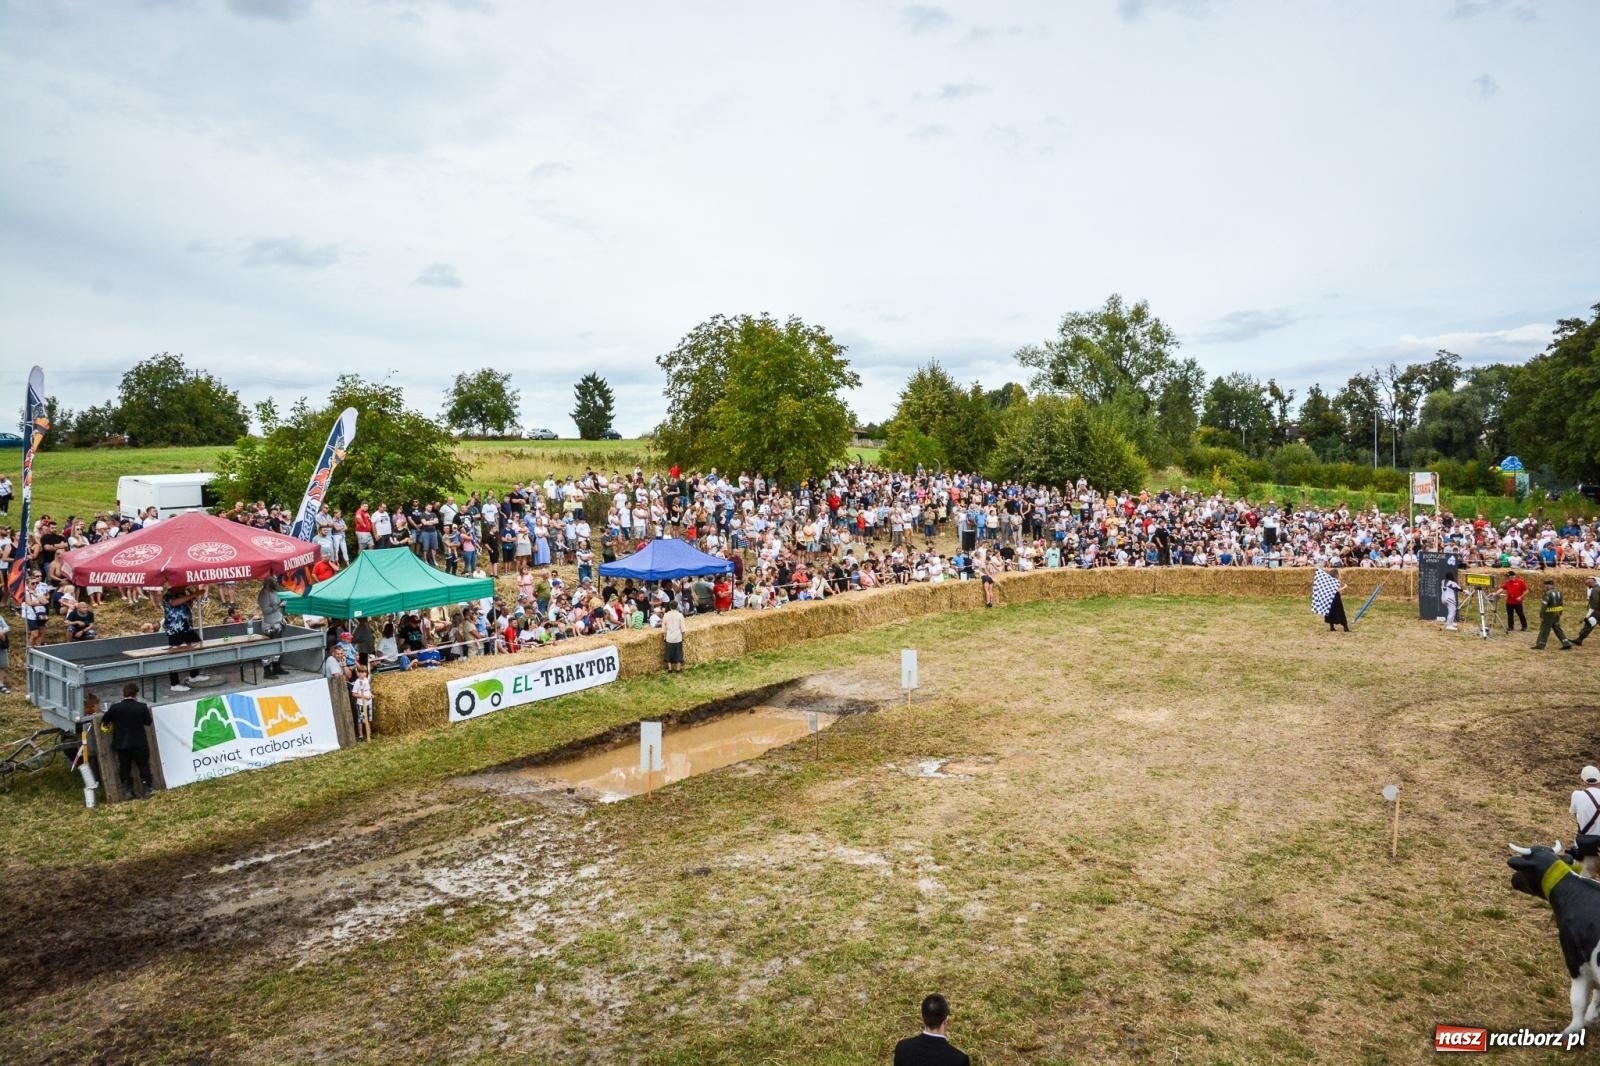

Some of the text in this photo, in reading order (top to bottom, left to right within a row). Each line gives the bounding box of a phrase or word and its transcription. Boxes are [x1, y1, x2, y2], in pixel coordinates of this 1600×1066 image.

[283, 551, 315, 571] RACIBORSKIE
[88, 571, 146, 584] RACIBORSKIE
[186, 565, 252, 583] RACIBORSKIE
[512, 655, 617, 694] EL-TRAKTOR
[192, 731, 314, 773] powiat raciborski
